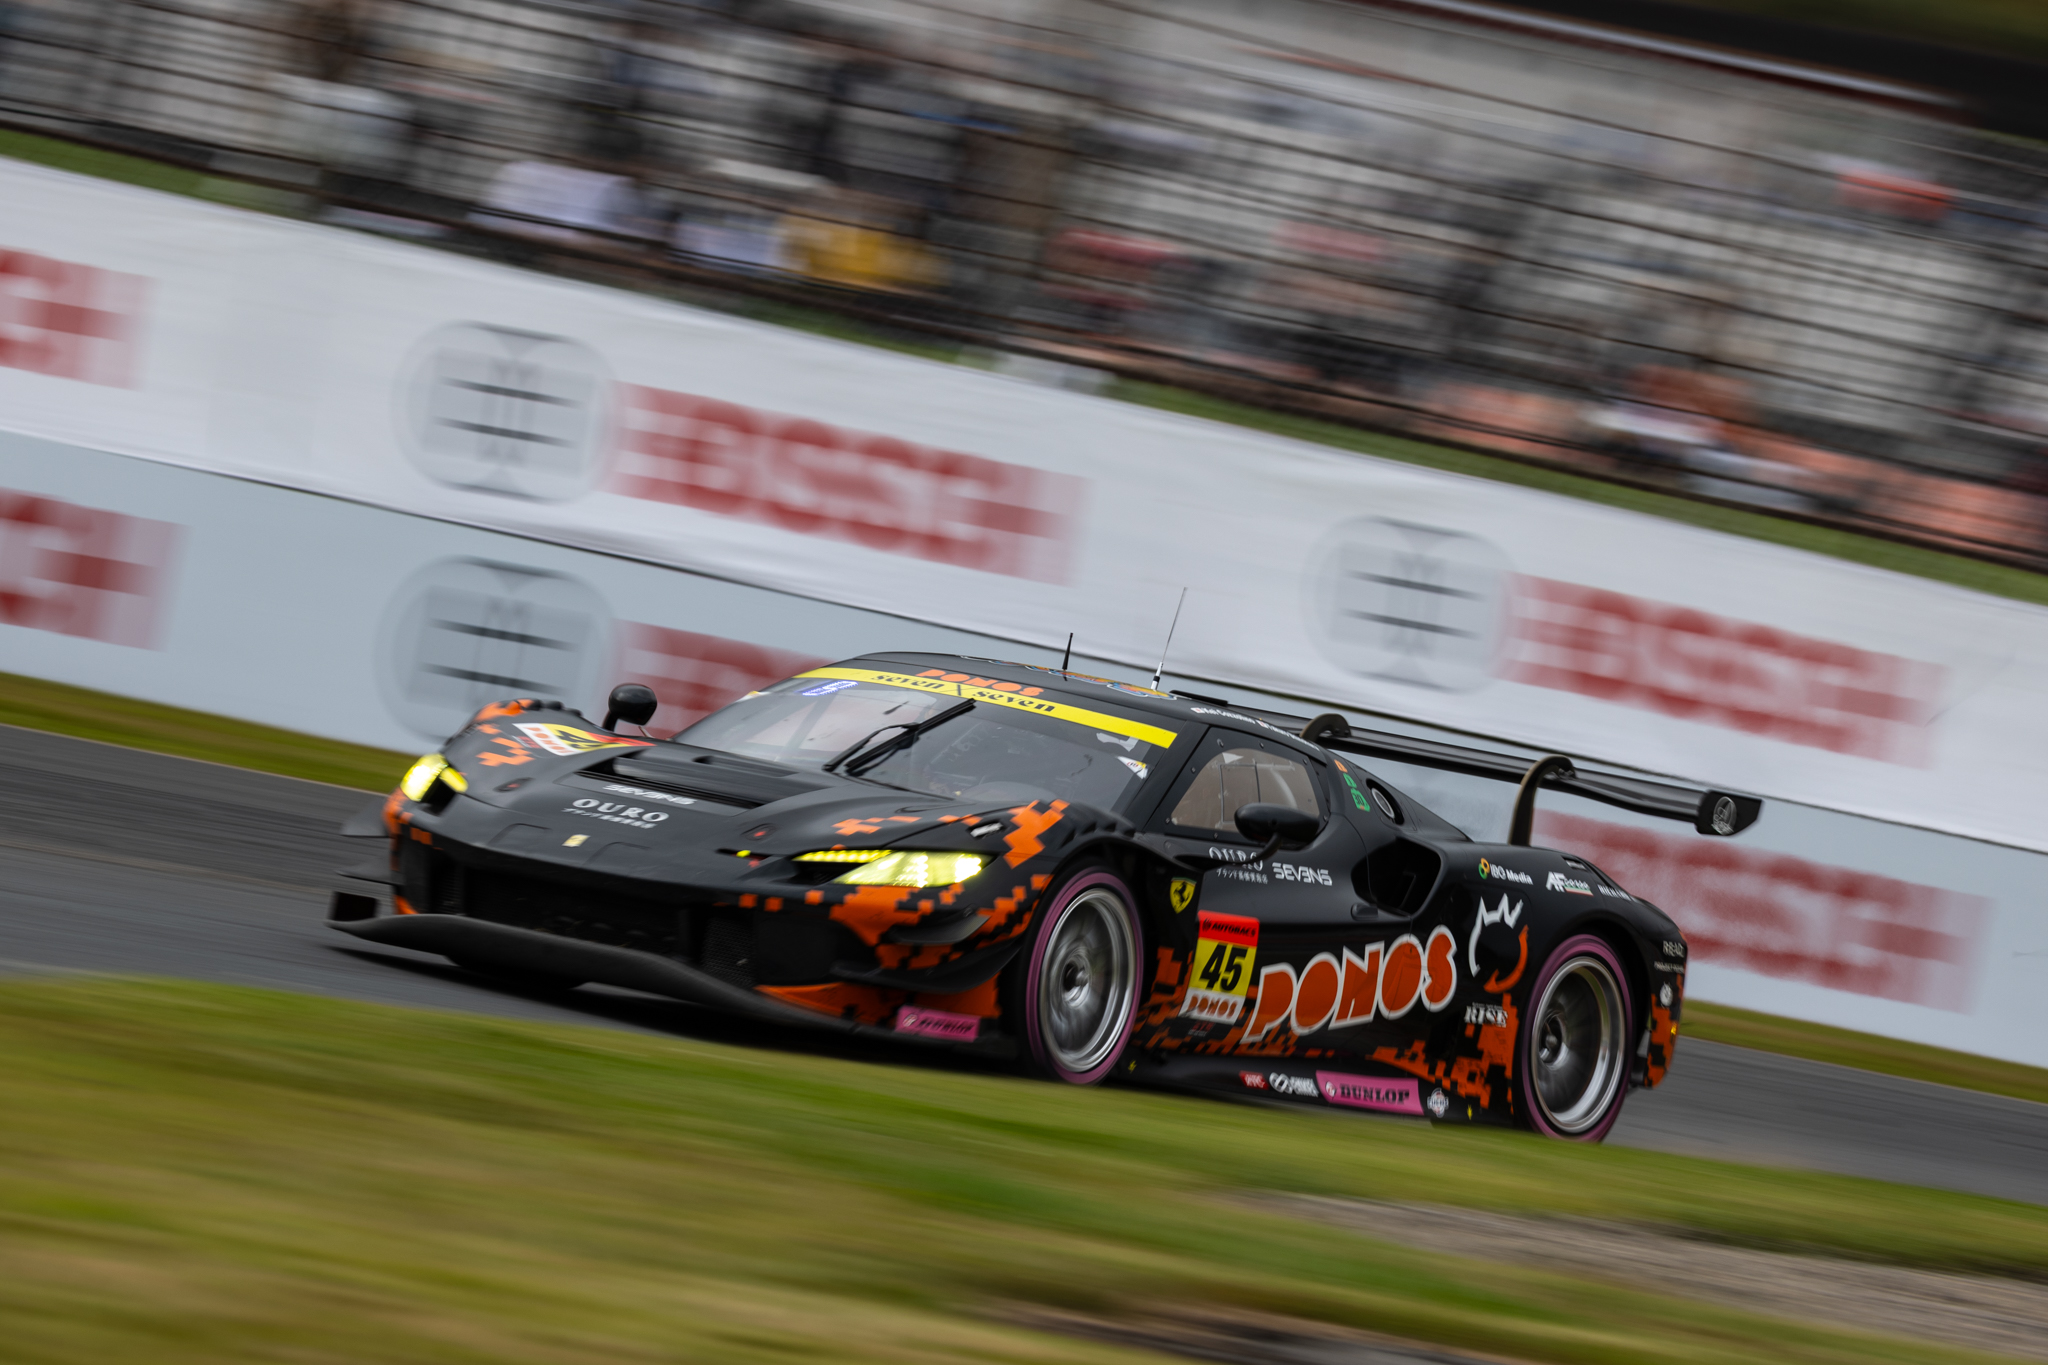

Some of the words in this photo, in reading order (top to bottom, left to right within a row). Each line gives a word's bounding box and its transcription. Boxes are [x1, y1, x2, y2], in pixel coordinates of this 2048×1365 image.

[873, 675, 941, 690] seven
[971, 690, 1056, 713] seven
[916, 669, 1045, 697] PONOS
[572, 798, 670, 823] OURO
[1272, 862, 1333, 886] SEVENS
[1211, 922, 1257, 938] AUTOBACS
[1199, 941, 1249, 992] 45
[1240, 924, 1458, 1044] PONOS
[1188, 994, 1238, 1020] PONOS
[1340, 1083, 1410, 1104] DUNLOP
